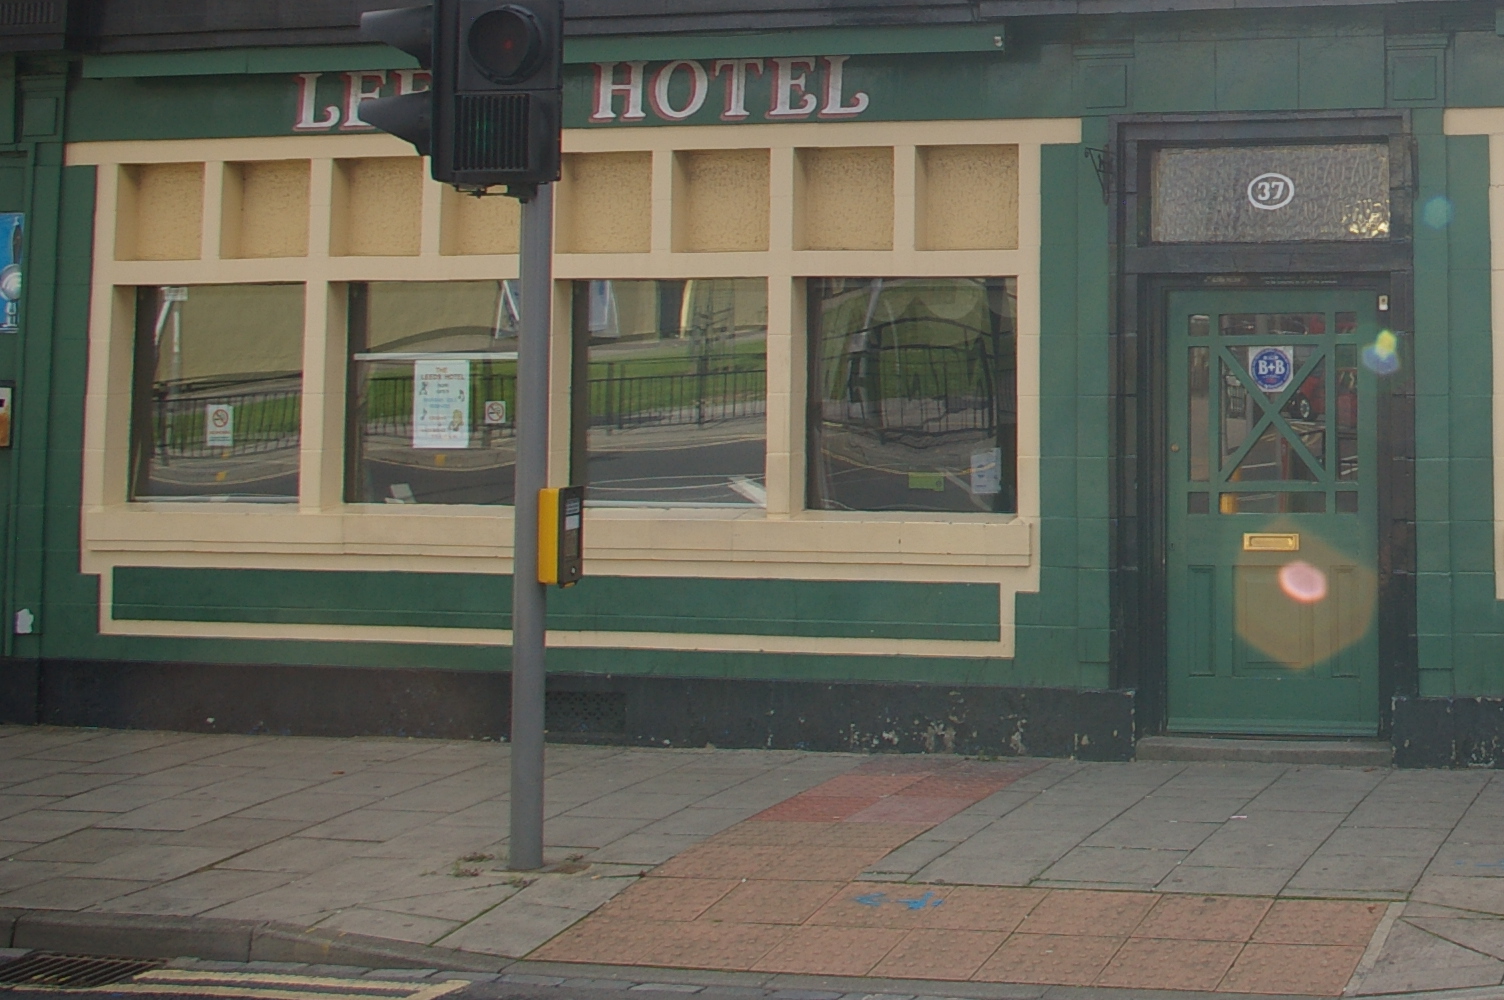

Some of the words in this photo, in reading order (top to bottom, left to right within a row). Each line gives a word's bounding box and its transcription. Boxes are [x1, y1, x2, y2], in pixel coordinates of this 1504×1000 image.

[590, 55, 869, 121] HOTEL
[1257, 181, 1284, 201] 37
[1258, 360, 1286, 375] B+B
